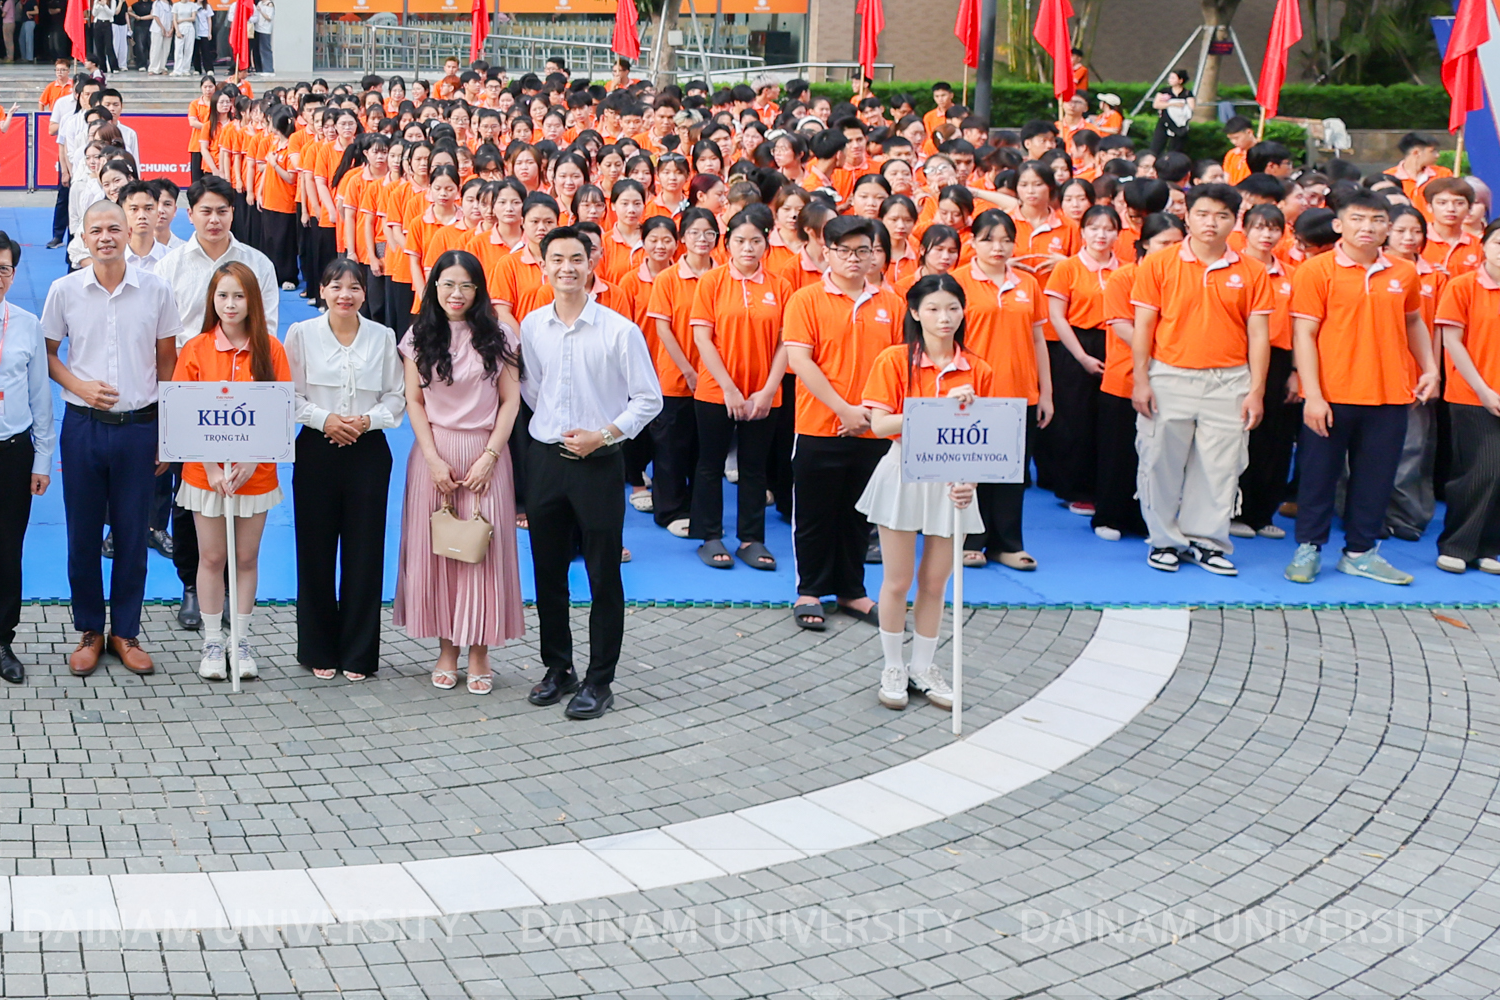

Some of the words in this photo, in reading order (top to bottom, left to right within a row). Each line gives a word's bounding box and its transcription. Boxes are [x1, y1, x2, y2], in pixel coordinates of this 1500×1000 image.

[139, 163, 178, 173] CHUNG
[197, 402, 256, 426] KHỐI
[936, 419, 989, 445] KHỐI
[204, 434, 234, 443] TRỌNG
[235, 433, 249, 442] TÀI
[916, 453, 934, 463] VẬN
[935, 452, 961, 463] ĐỘNG
[962, 452, 984, 462] VIÊN
[984, 453, 1008, 462] YOGA
